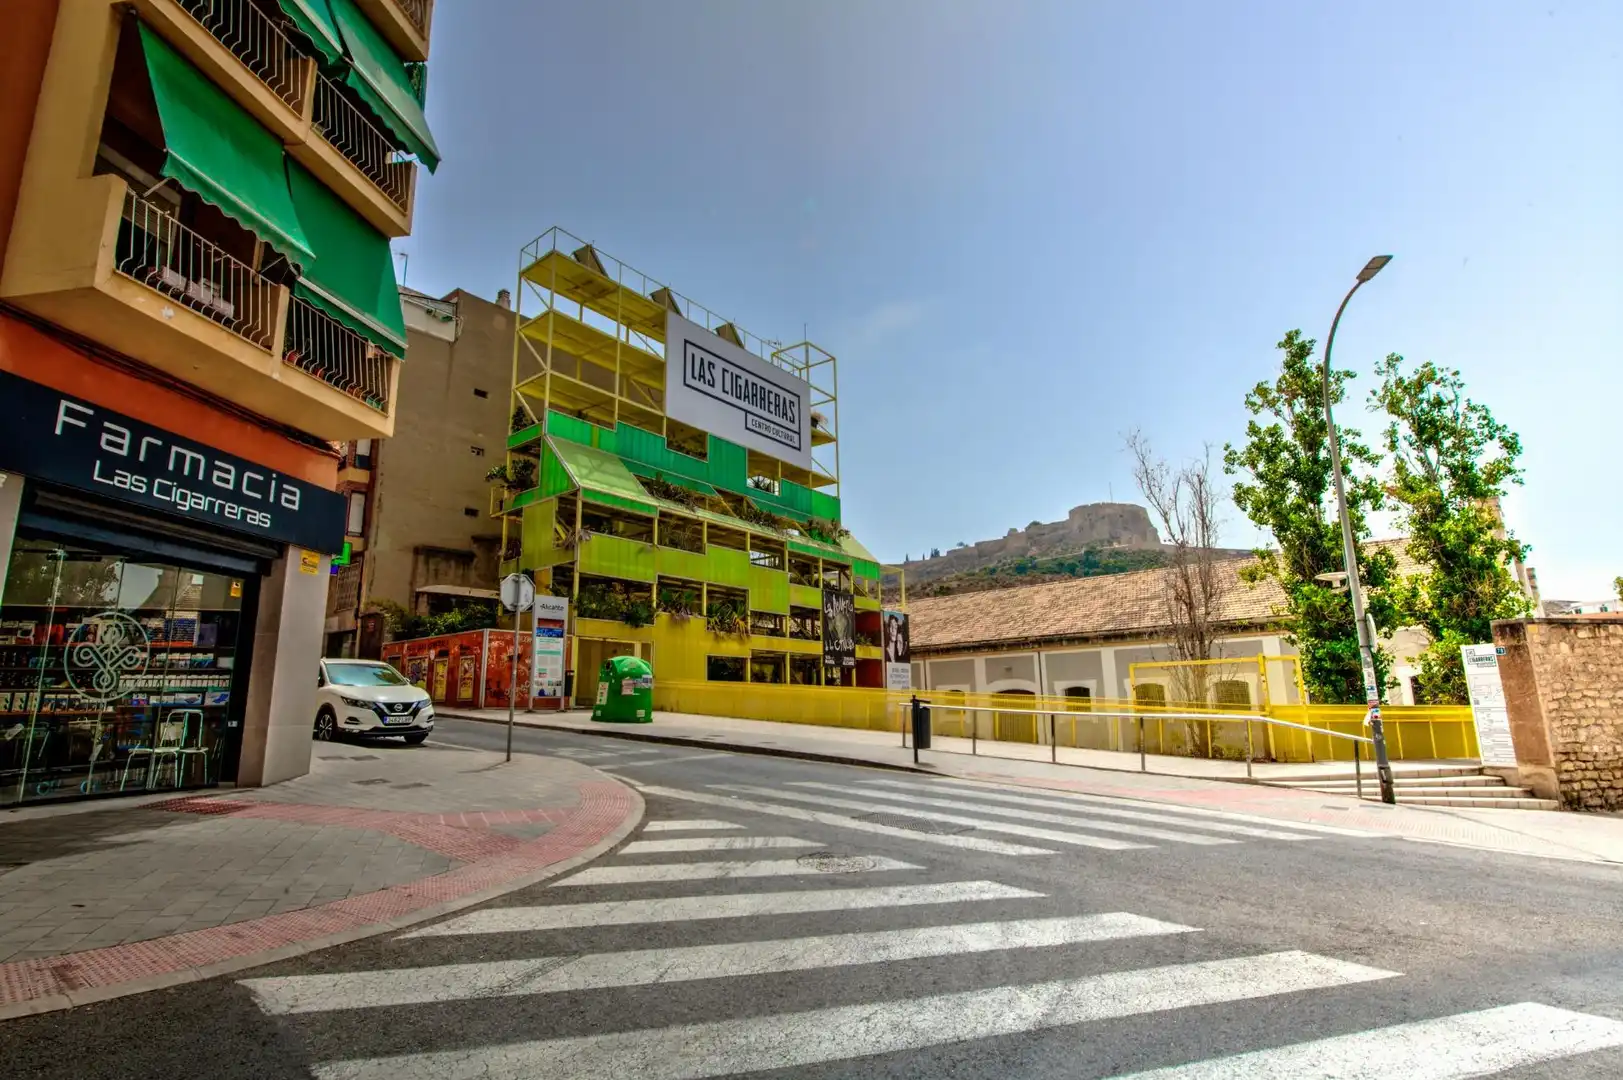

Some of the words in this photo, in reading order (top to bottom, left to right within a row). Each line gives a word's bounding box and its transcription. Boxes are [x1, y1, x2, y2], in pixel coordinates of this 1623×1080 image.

[691, 352, 715, 388] LAS
[721, 367, 796, 425] CIGARRERAS
[54, 399, 301, 511] Farmacia
[751, 418, 772, 433] CENTRO
[772, 427, 796, 444] CULTURAL
[93, 459, 148, 494] Las
[153, 478, 272, 528] Cigarreras
